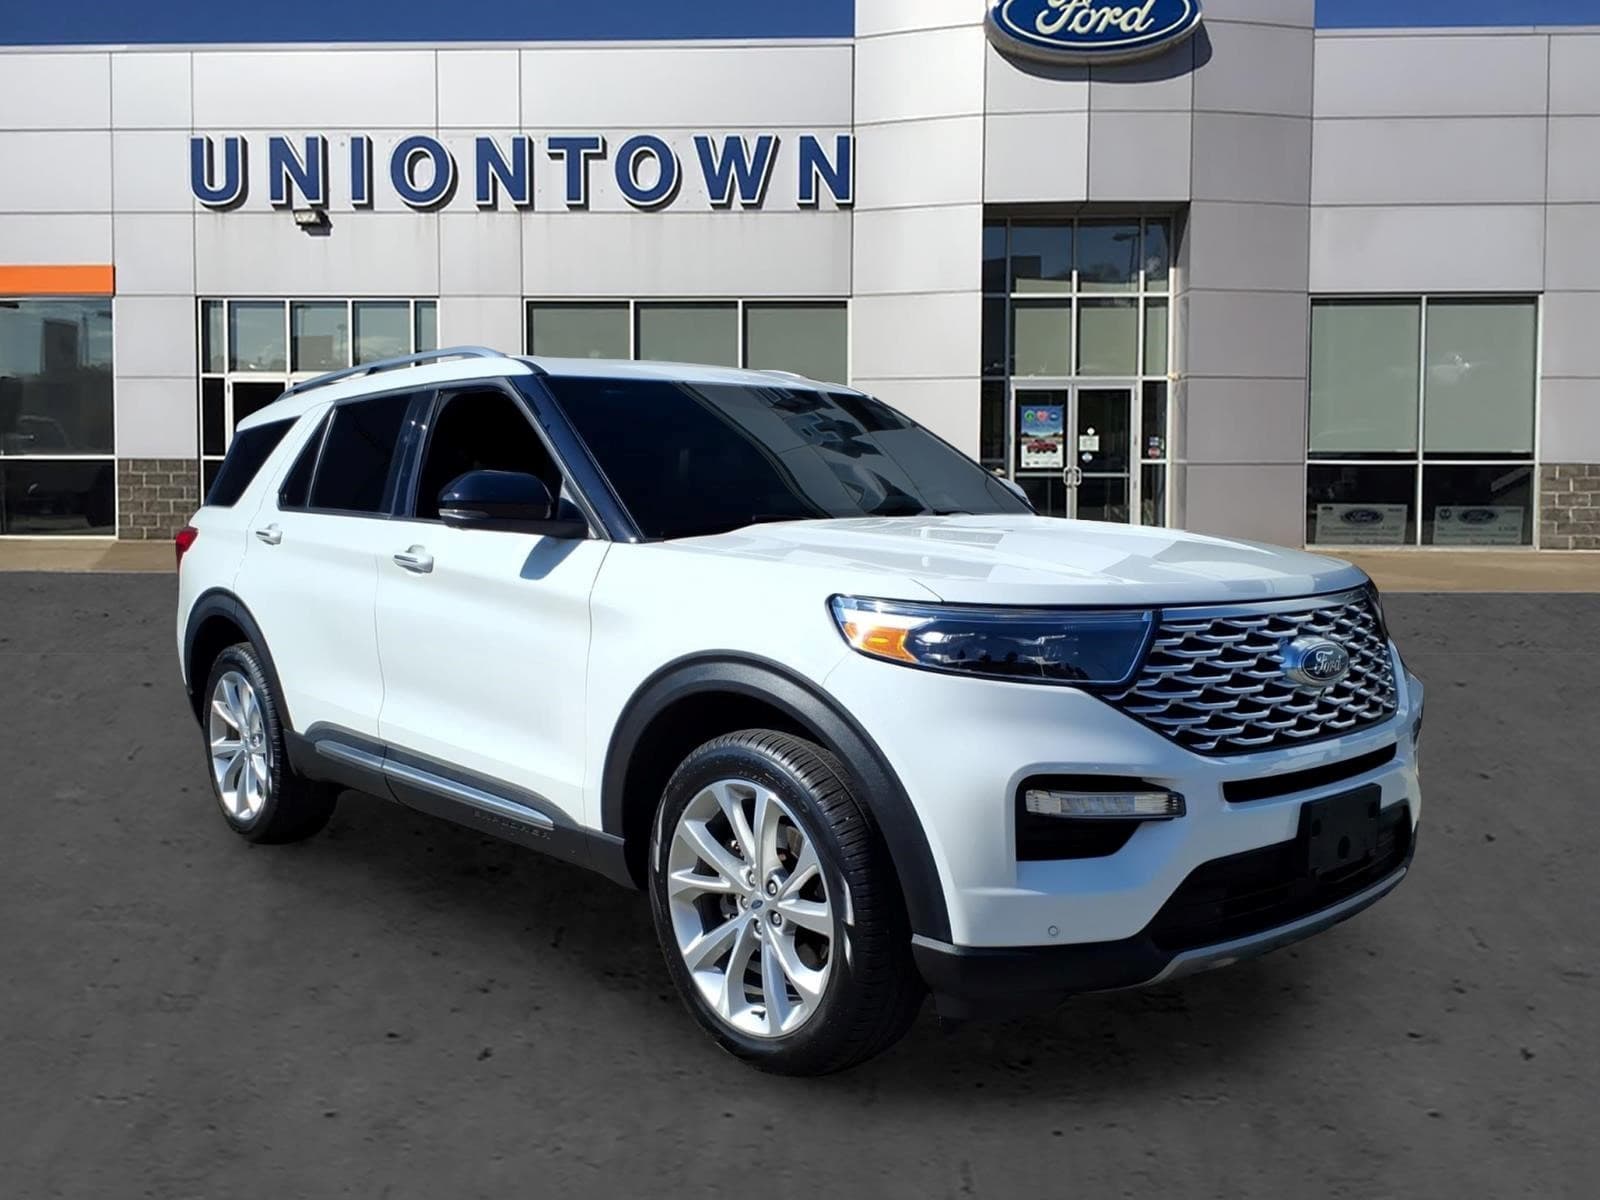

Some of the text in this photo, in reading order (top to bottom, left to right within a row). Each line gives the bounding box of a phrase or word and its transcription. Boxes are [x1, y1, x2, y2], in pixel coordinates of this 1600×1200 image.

[1035, 0, 1156, 35] Ford
[189, 133, 854, 209] UNIONTOWN
[1312, 650, 1342, 675] Ford
